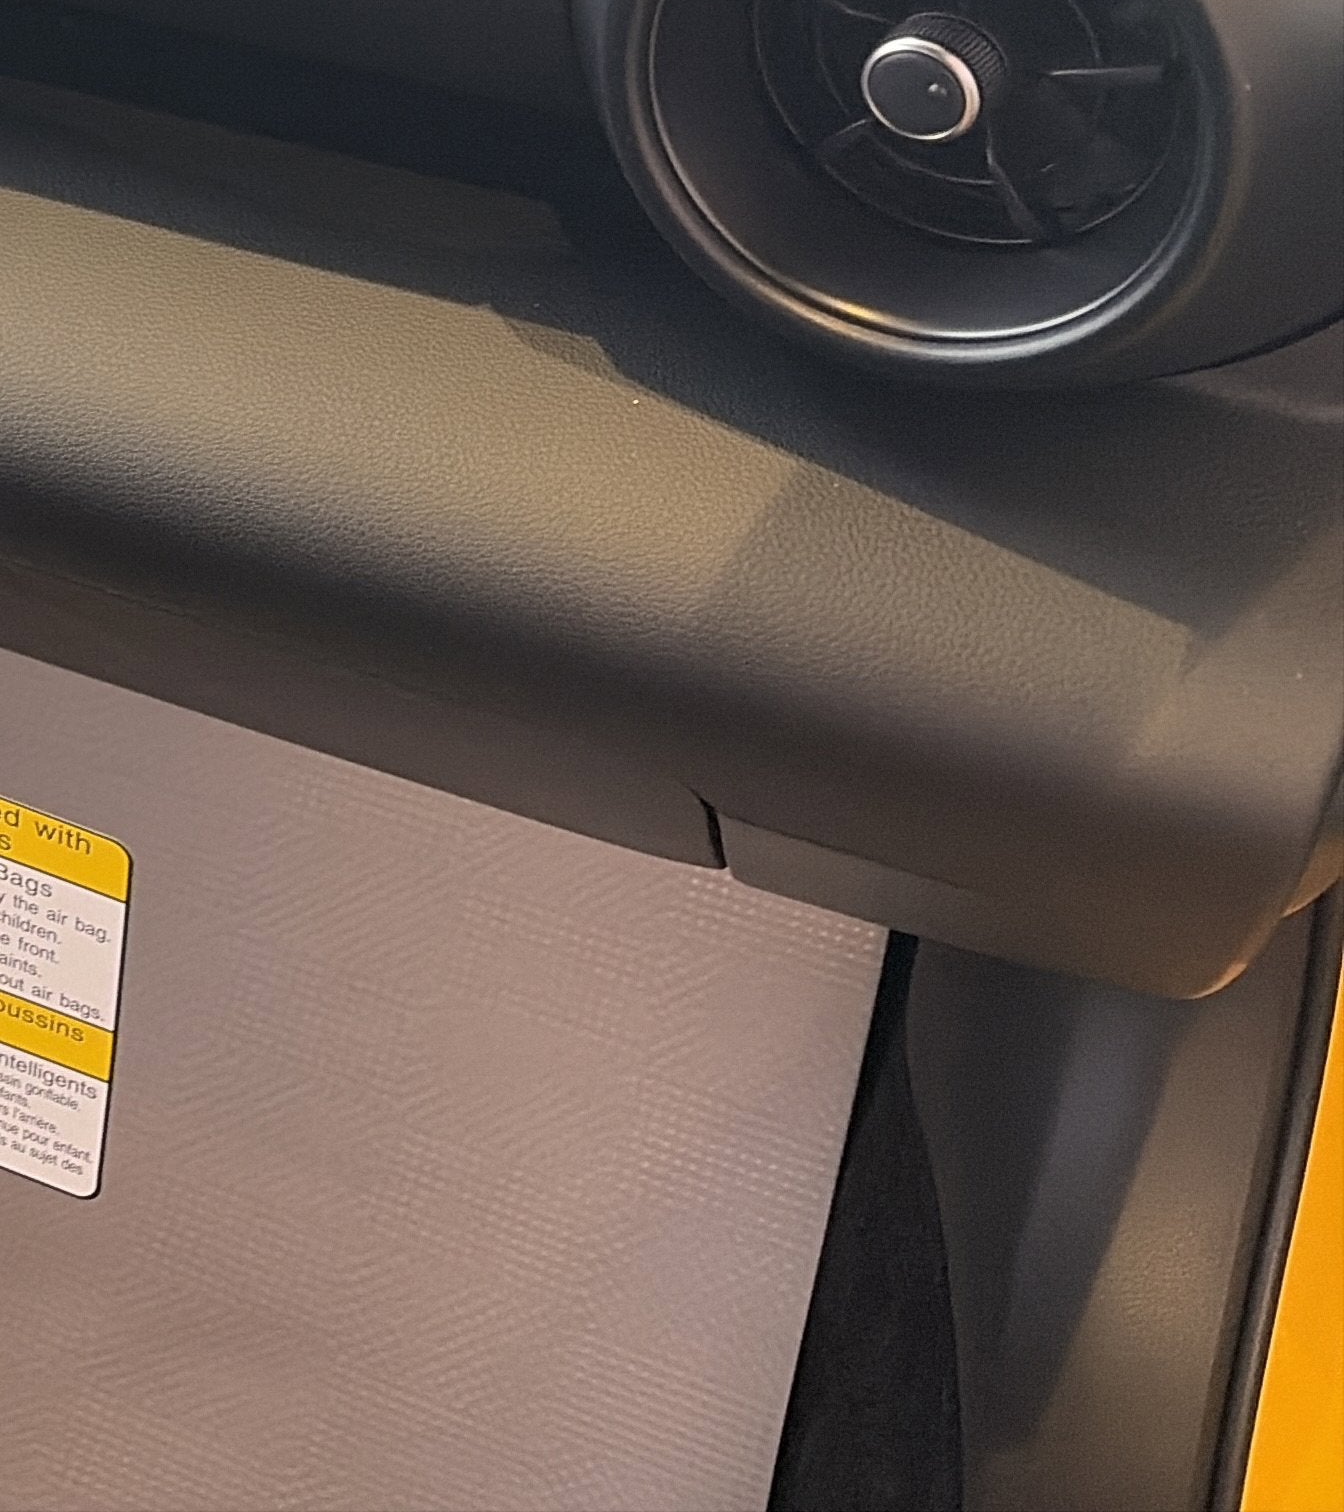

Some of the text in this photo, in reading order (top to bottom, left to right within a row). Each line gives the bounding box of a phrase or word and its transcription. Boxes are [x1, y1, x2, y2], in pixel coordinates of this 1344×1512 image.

[33, 820, 92, 856] with
[12, 893, 40, 916] the
[45, 908, 70, 926] air
[74, 915, 113, 944] bag.
[17, 935, 60, 965] front.
[30, 984, 55, 1002] air
[58, 992, 106, 1023] bags.
